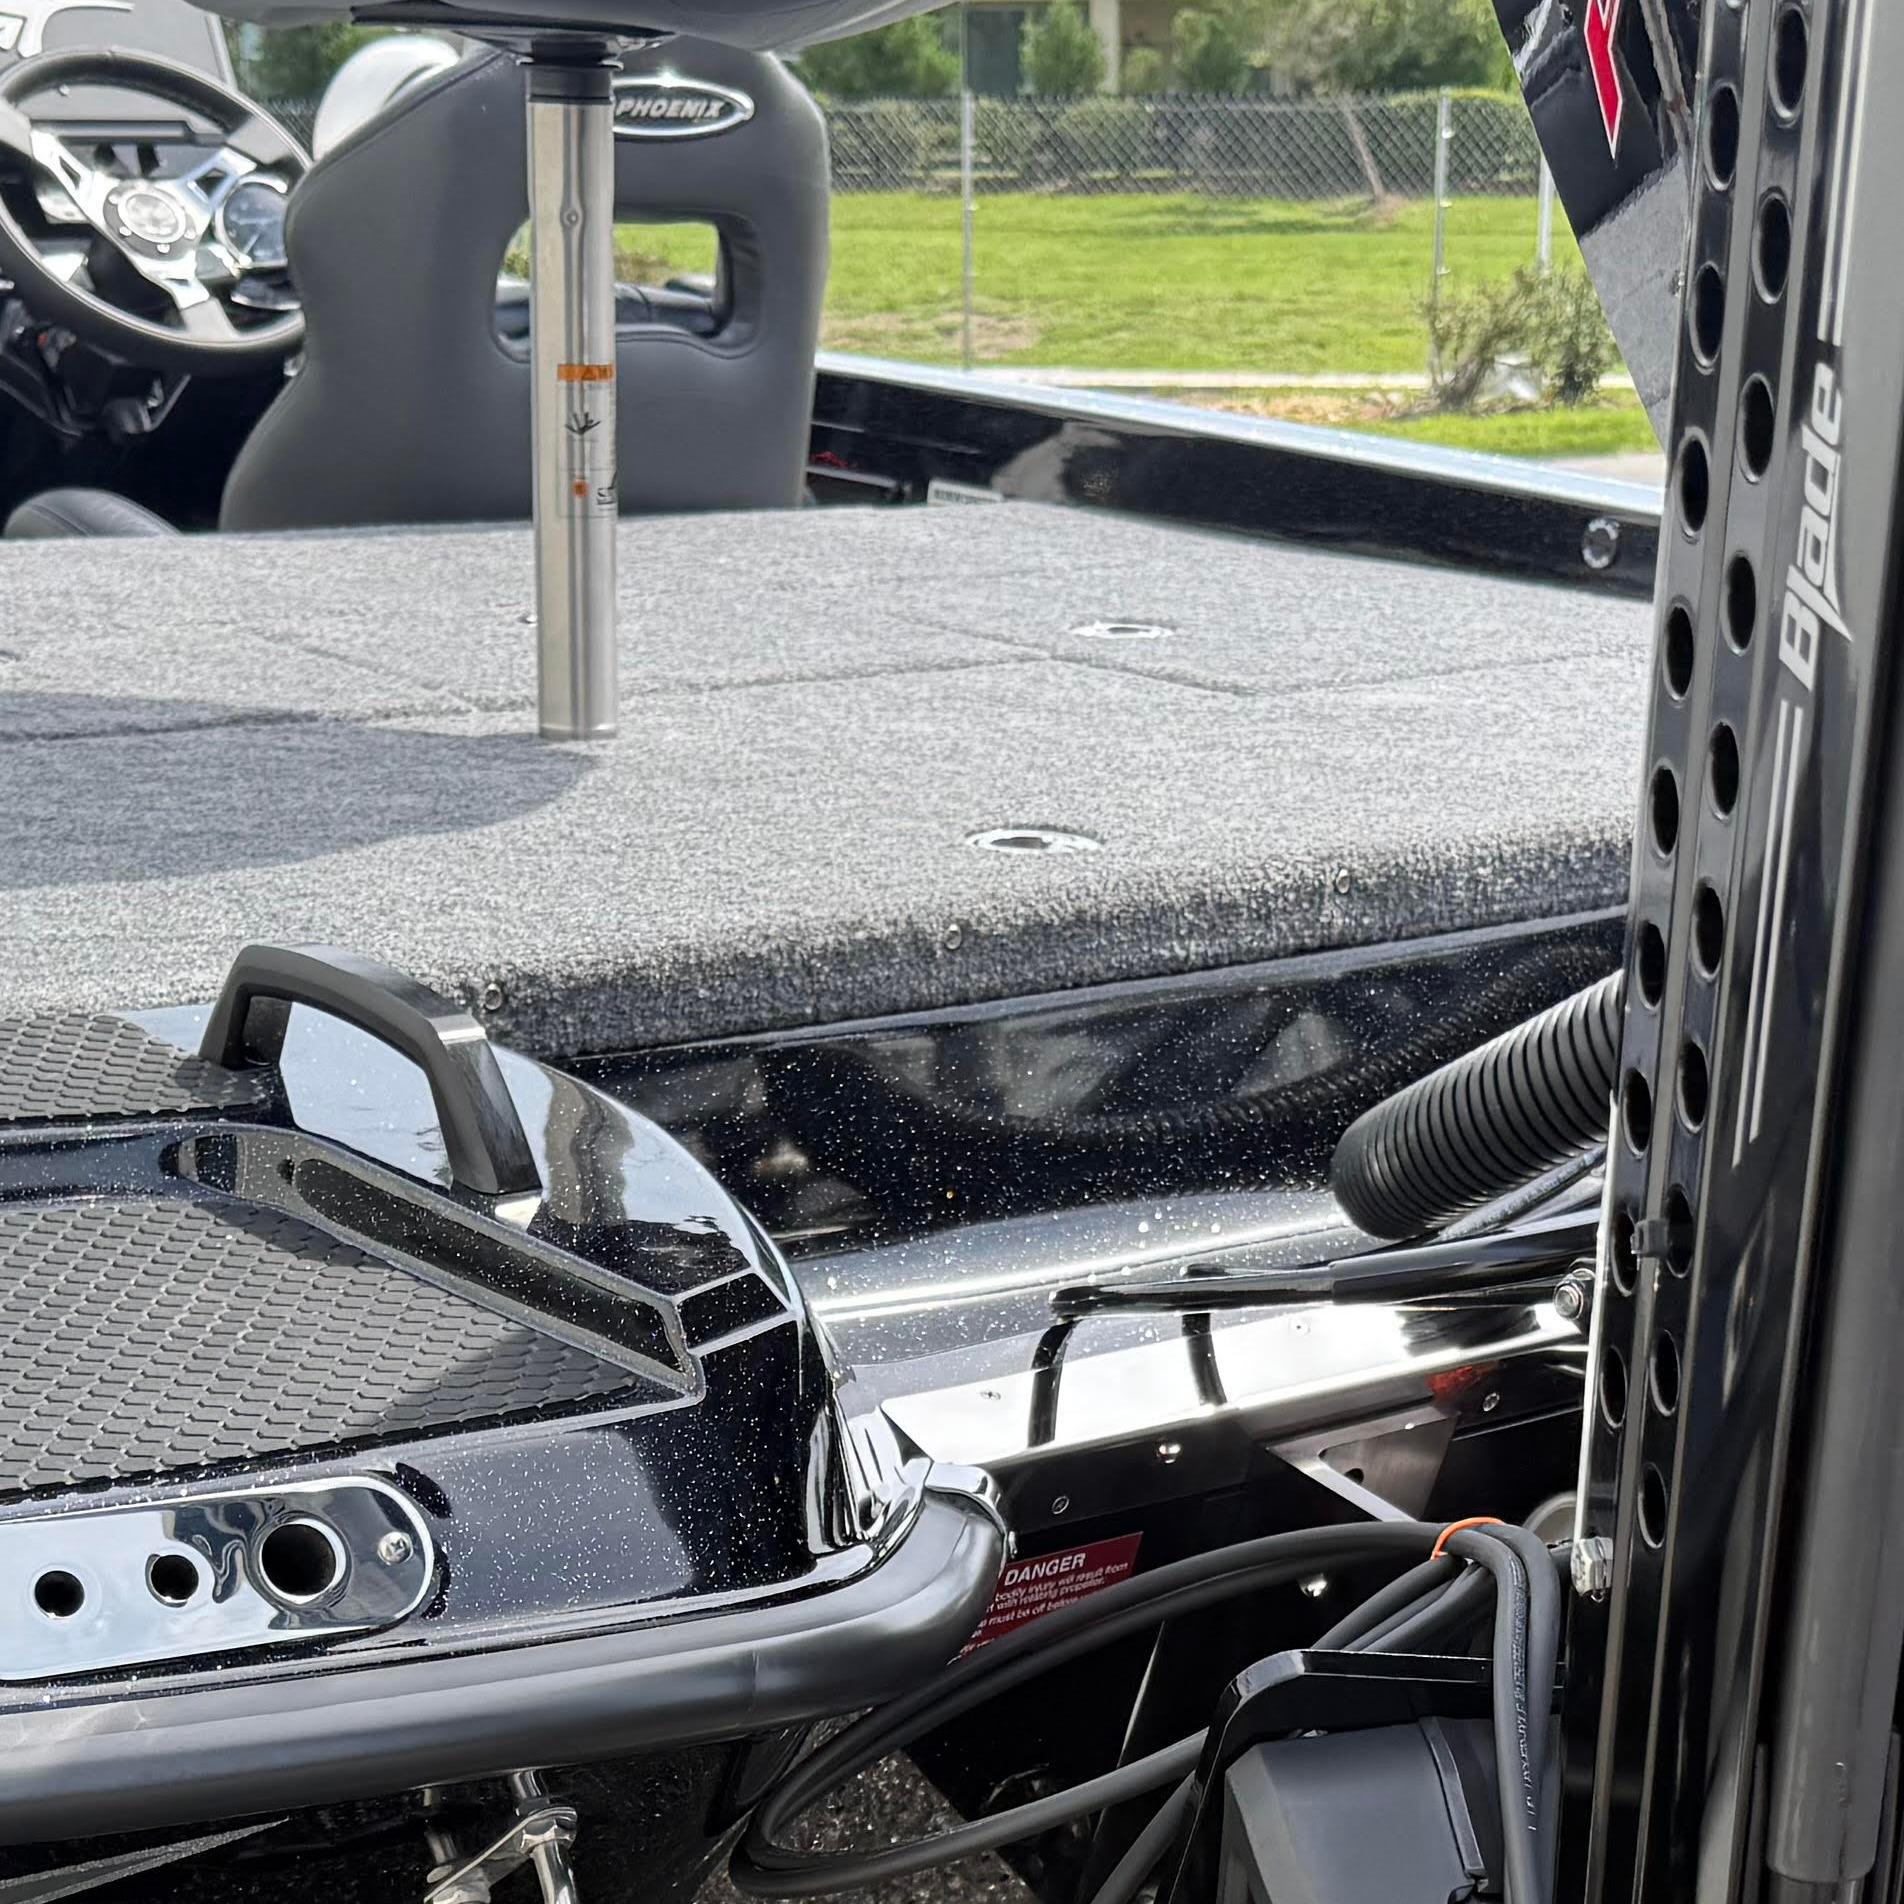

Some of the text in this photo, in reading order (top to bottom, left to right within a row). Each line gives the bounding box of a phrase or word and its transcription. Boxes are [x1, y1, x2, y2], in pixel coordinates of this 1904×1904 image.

[615, 97, 726, 118] PHOENIX
[1779, 362, 1854, 691] Blade
[1004, 1553, 1086, 1586] DANGER
[1104, 1562, 1129, 1575] from
